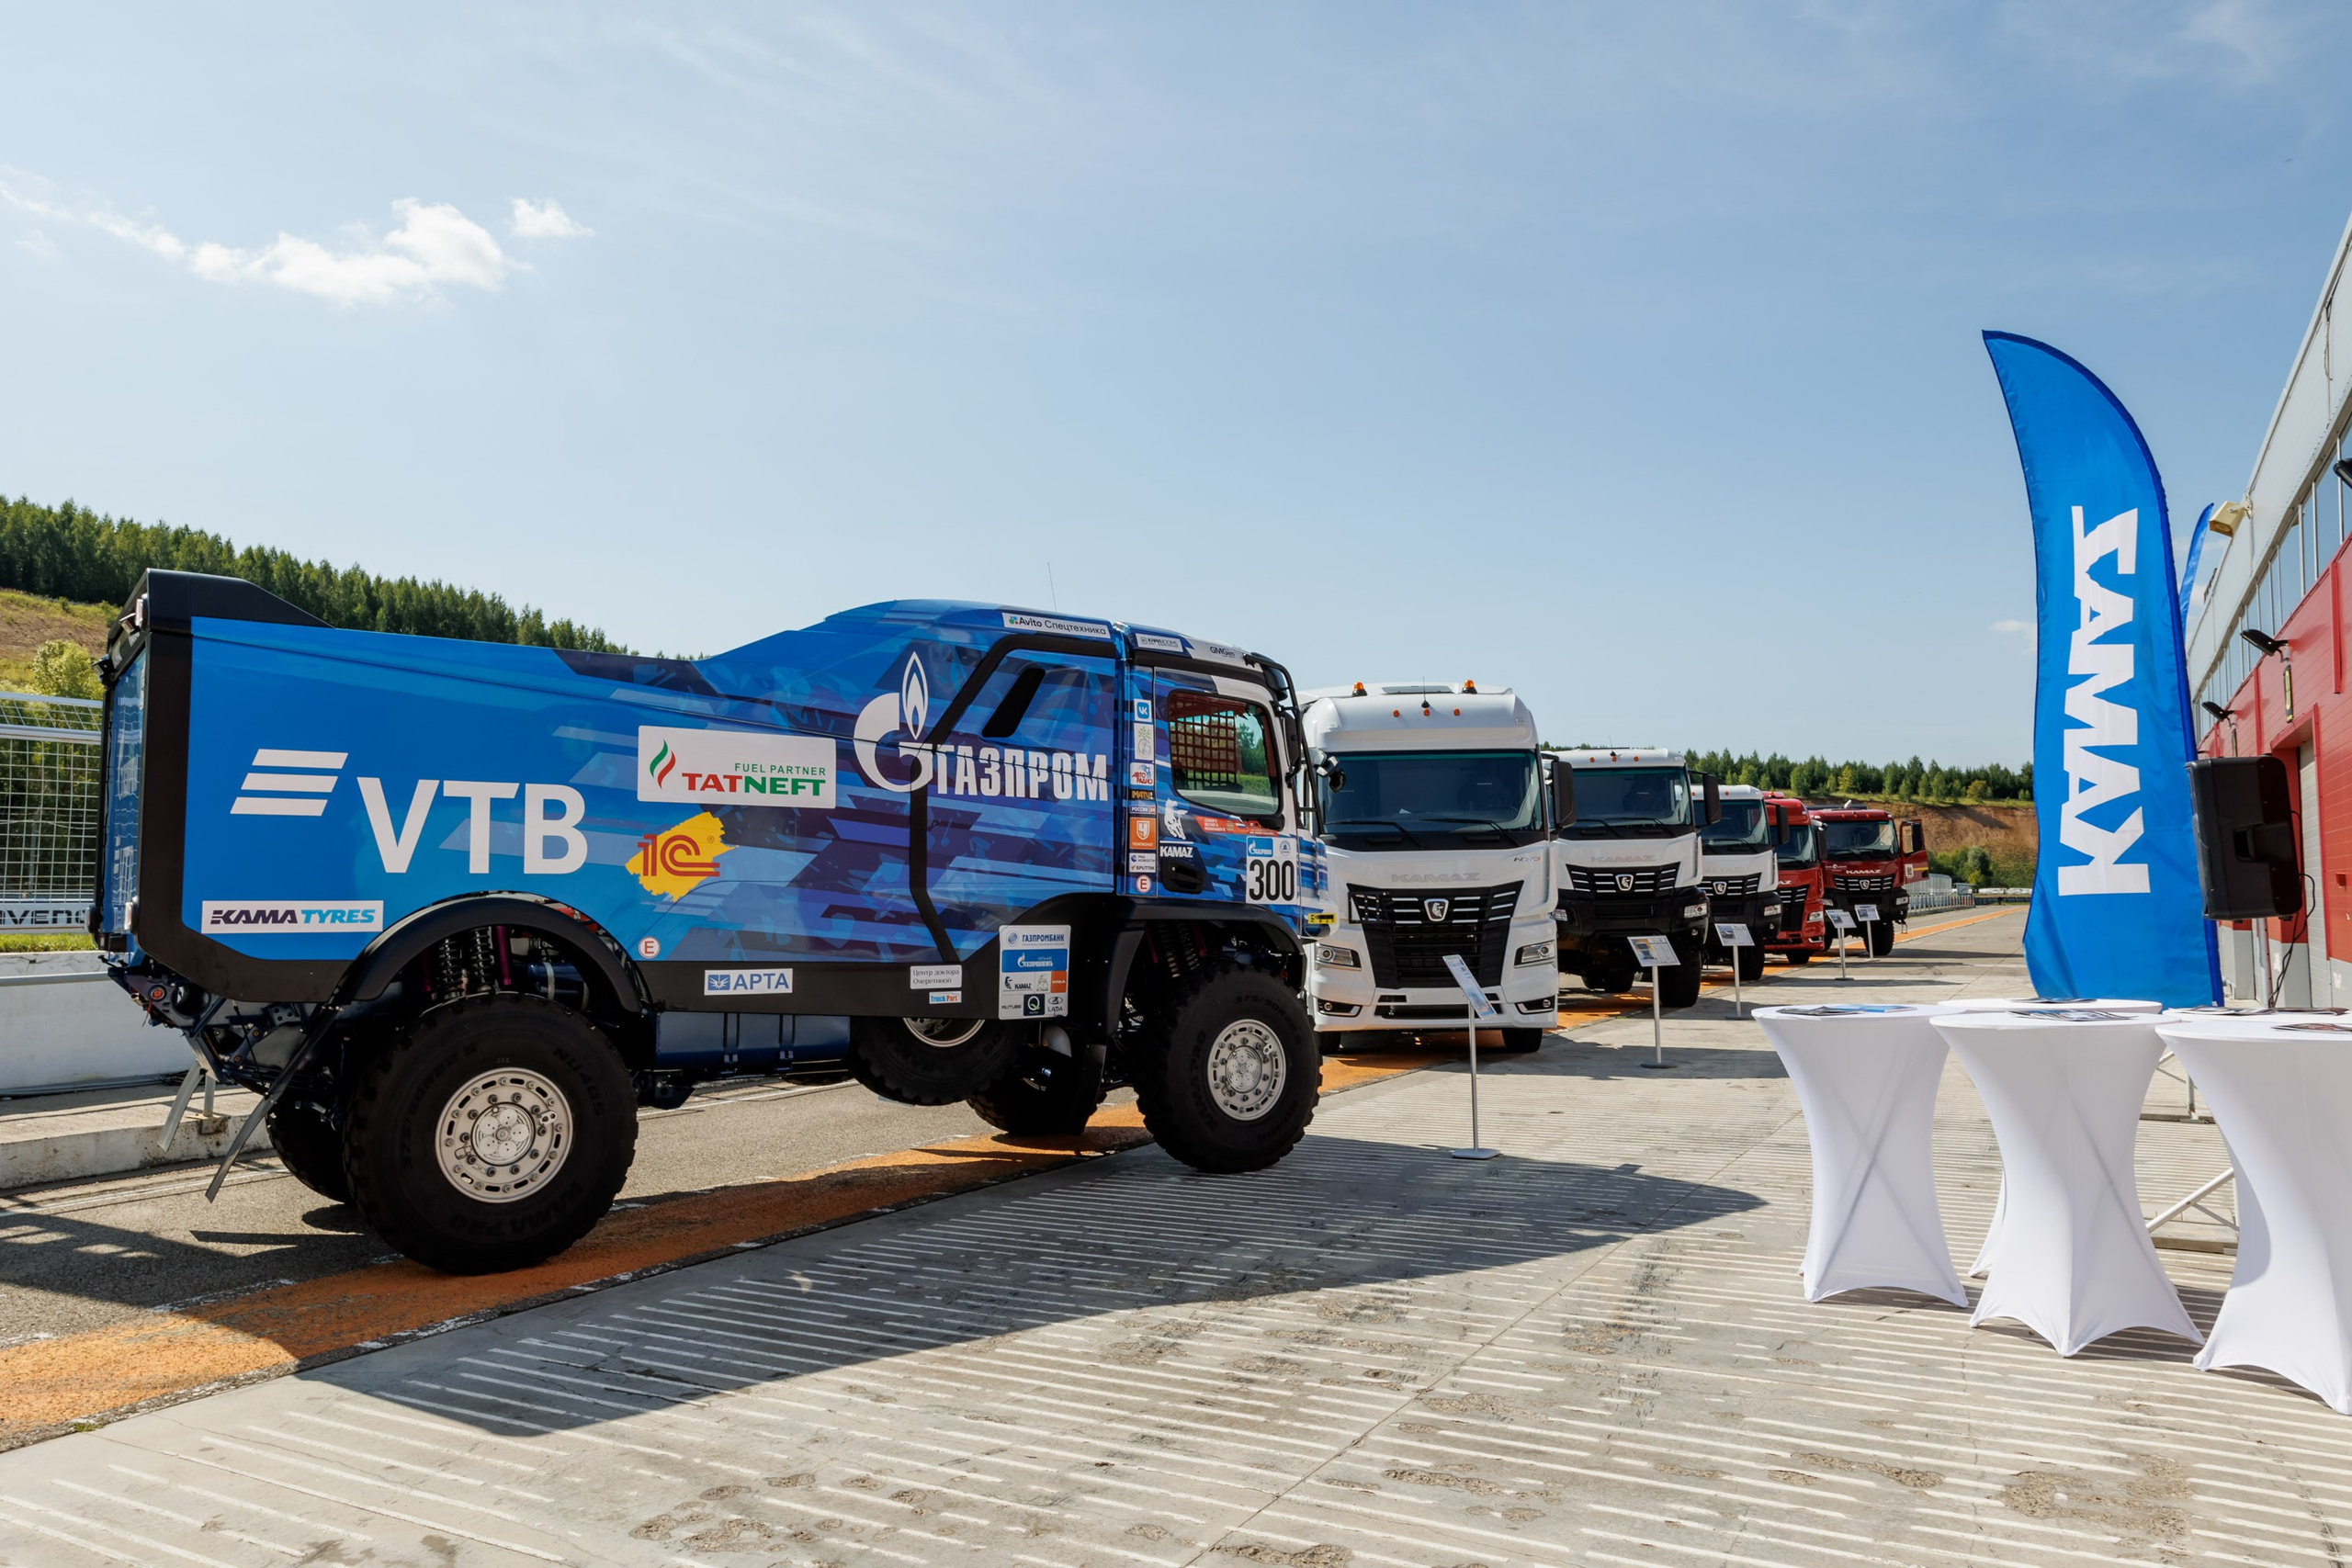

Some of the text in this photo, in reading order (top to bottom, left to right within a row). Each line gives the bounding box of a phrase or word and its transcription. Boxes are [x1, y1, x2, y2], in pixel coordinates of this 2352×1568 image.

[1019, 616, 1106, 635] Avito Спецтехника
[1138, 705, 1148, 716] VK
[735, 762, 826, 776] FUEL PARTNER
[936, 744, 1108, 802] ГАЗПРОМ
[682, 773, 826, 796] TATNEFT
[356, 776, 588, 874] VTB
[1159, 845, 1193, 858] KAMAZ
[1590, 855, 1656, 863] KAMAZ
[1140, 878, 1148, 890] E
[1249, 859, 1295, 901] 300
[1390, 873, 1481, 883] KAMAZ
[210, 909, 376, 924] KAMA TYRES
[1022, 933, 1065, 942] ГАЗПРОМБАНК
[644, 941, 655, 954] E
